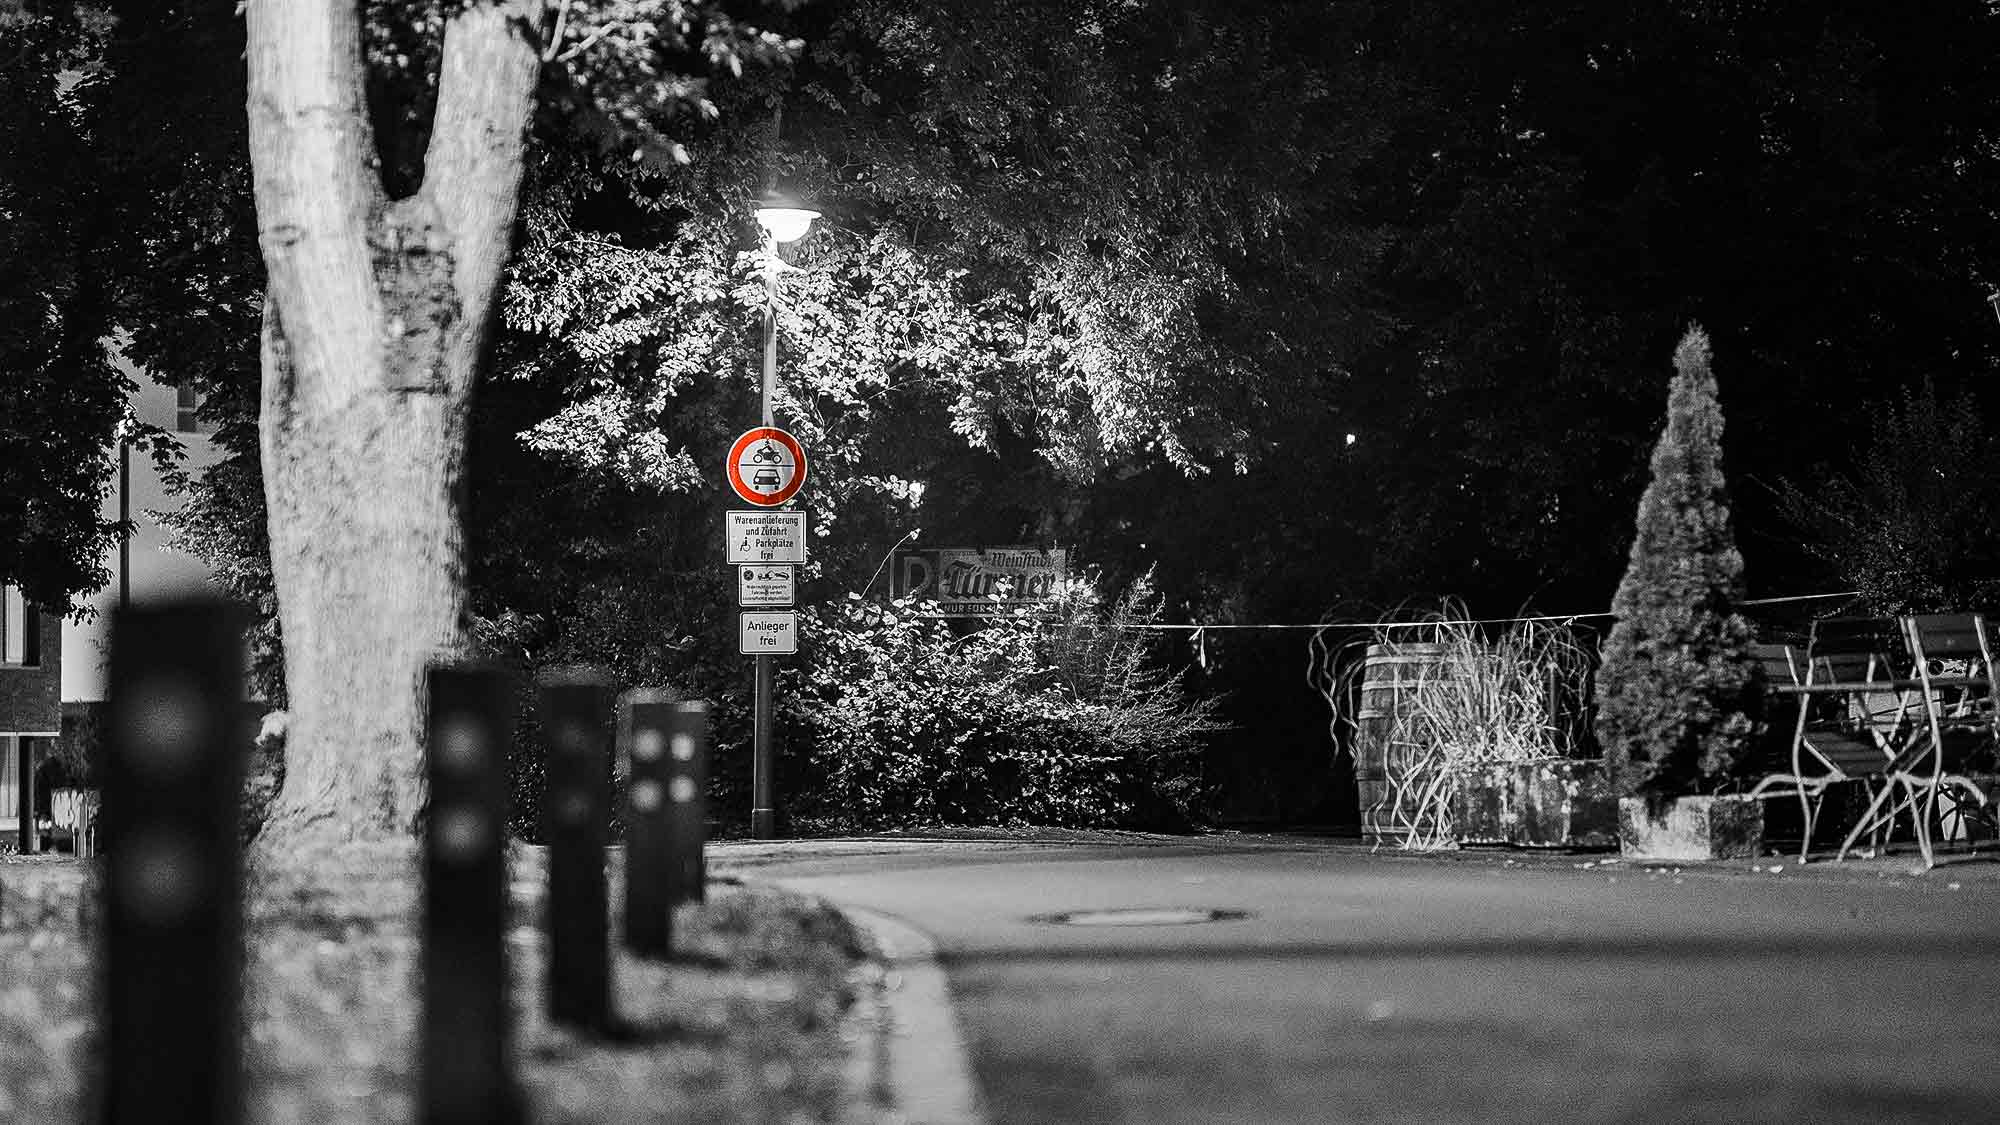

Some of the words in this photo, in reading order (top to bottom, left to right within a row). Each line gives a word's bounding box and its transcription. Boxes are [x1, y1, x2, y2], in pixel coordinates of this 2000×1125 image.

[735, 515, 799, 527] Warenanlieferung
[745, 527, 759, 536] und
[760, 526, 788, 536] Zufahrt
[755, 538, 794, 549] Parkplätze
[760, 551, 774, 560] frei
[747, 621, 789, 633] Anlieger
[760, 635, 777, 646] frei
